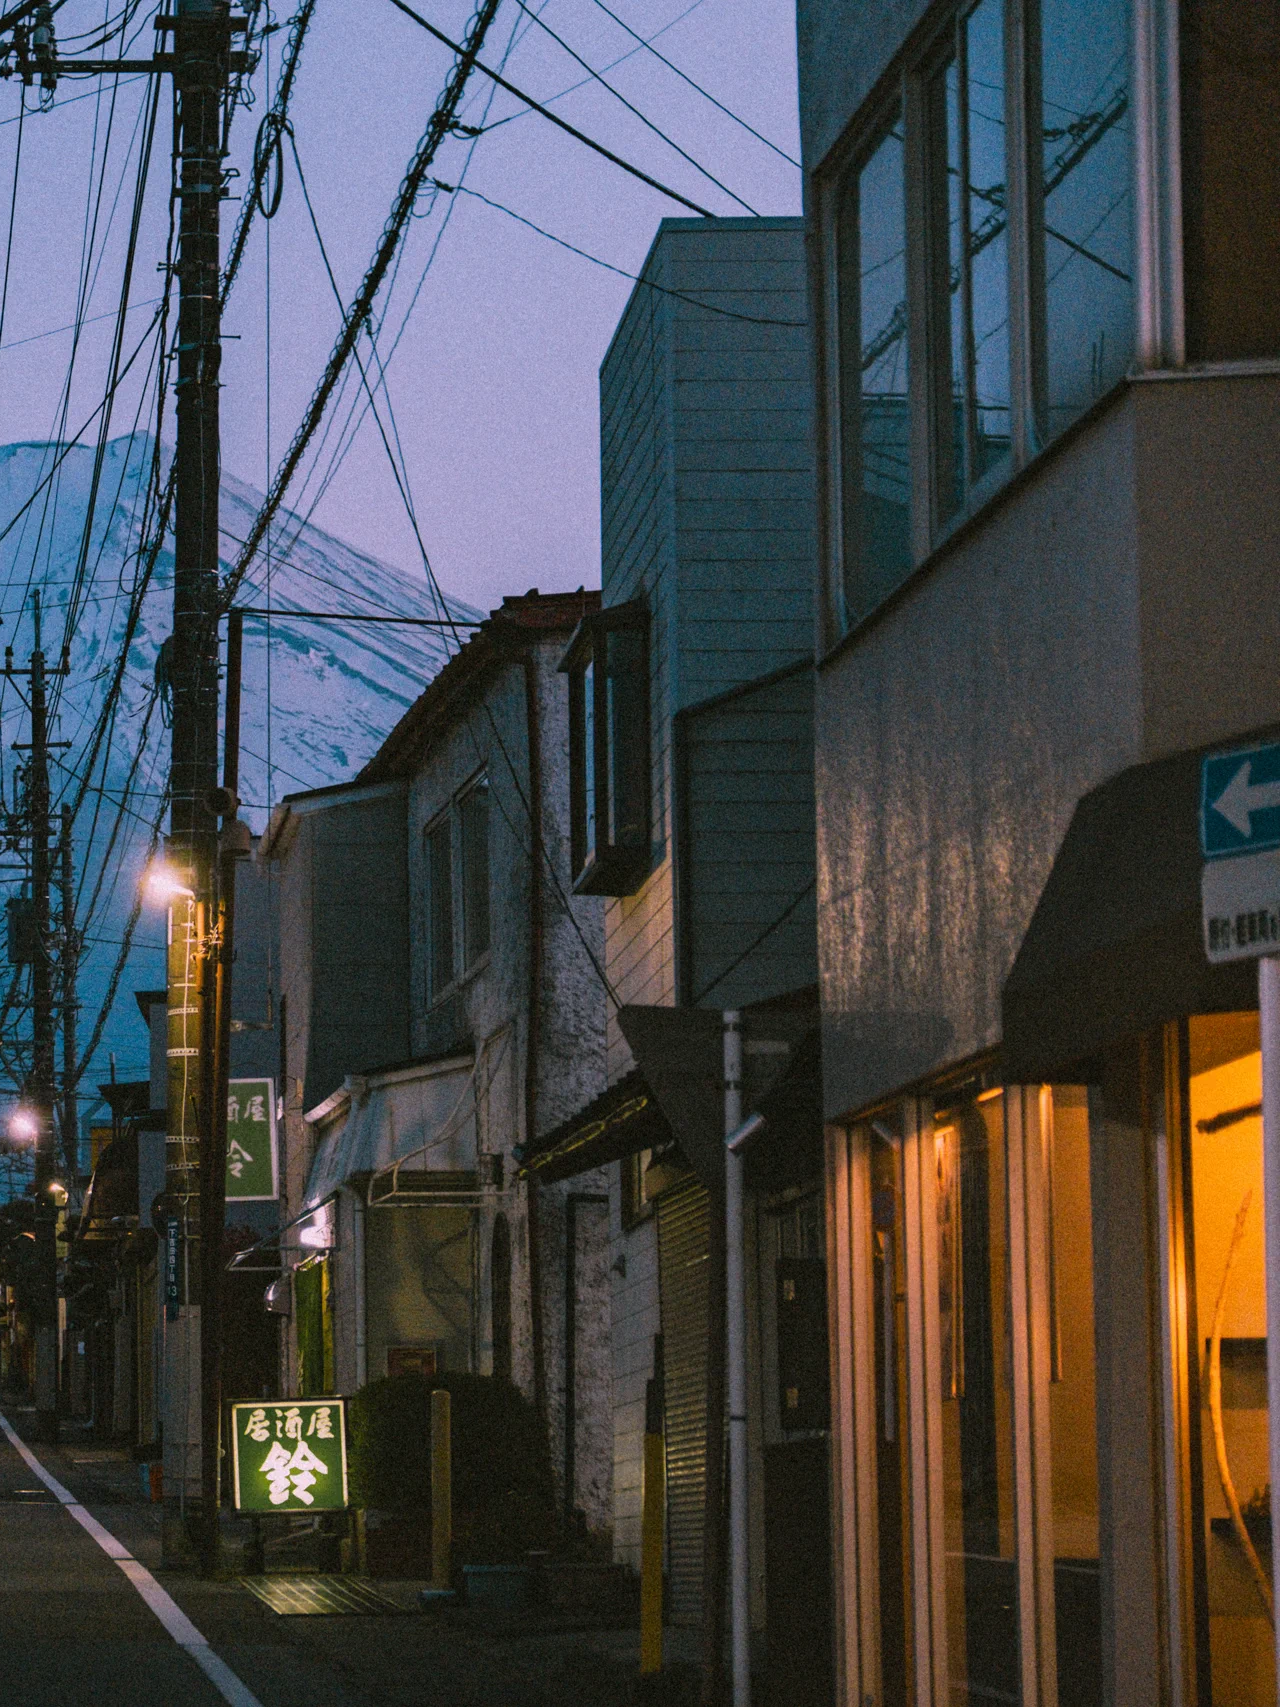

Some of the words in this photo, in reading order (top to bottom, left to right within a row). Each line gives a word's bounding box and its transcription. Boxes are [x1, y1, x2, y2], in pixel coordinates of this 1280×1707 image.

[244, 1407, 334, 1442] 居酒屋
[259, 1441, 328, 1505] 鈴
